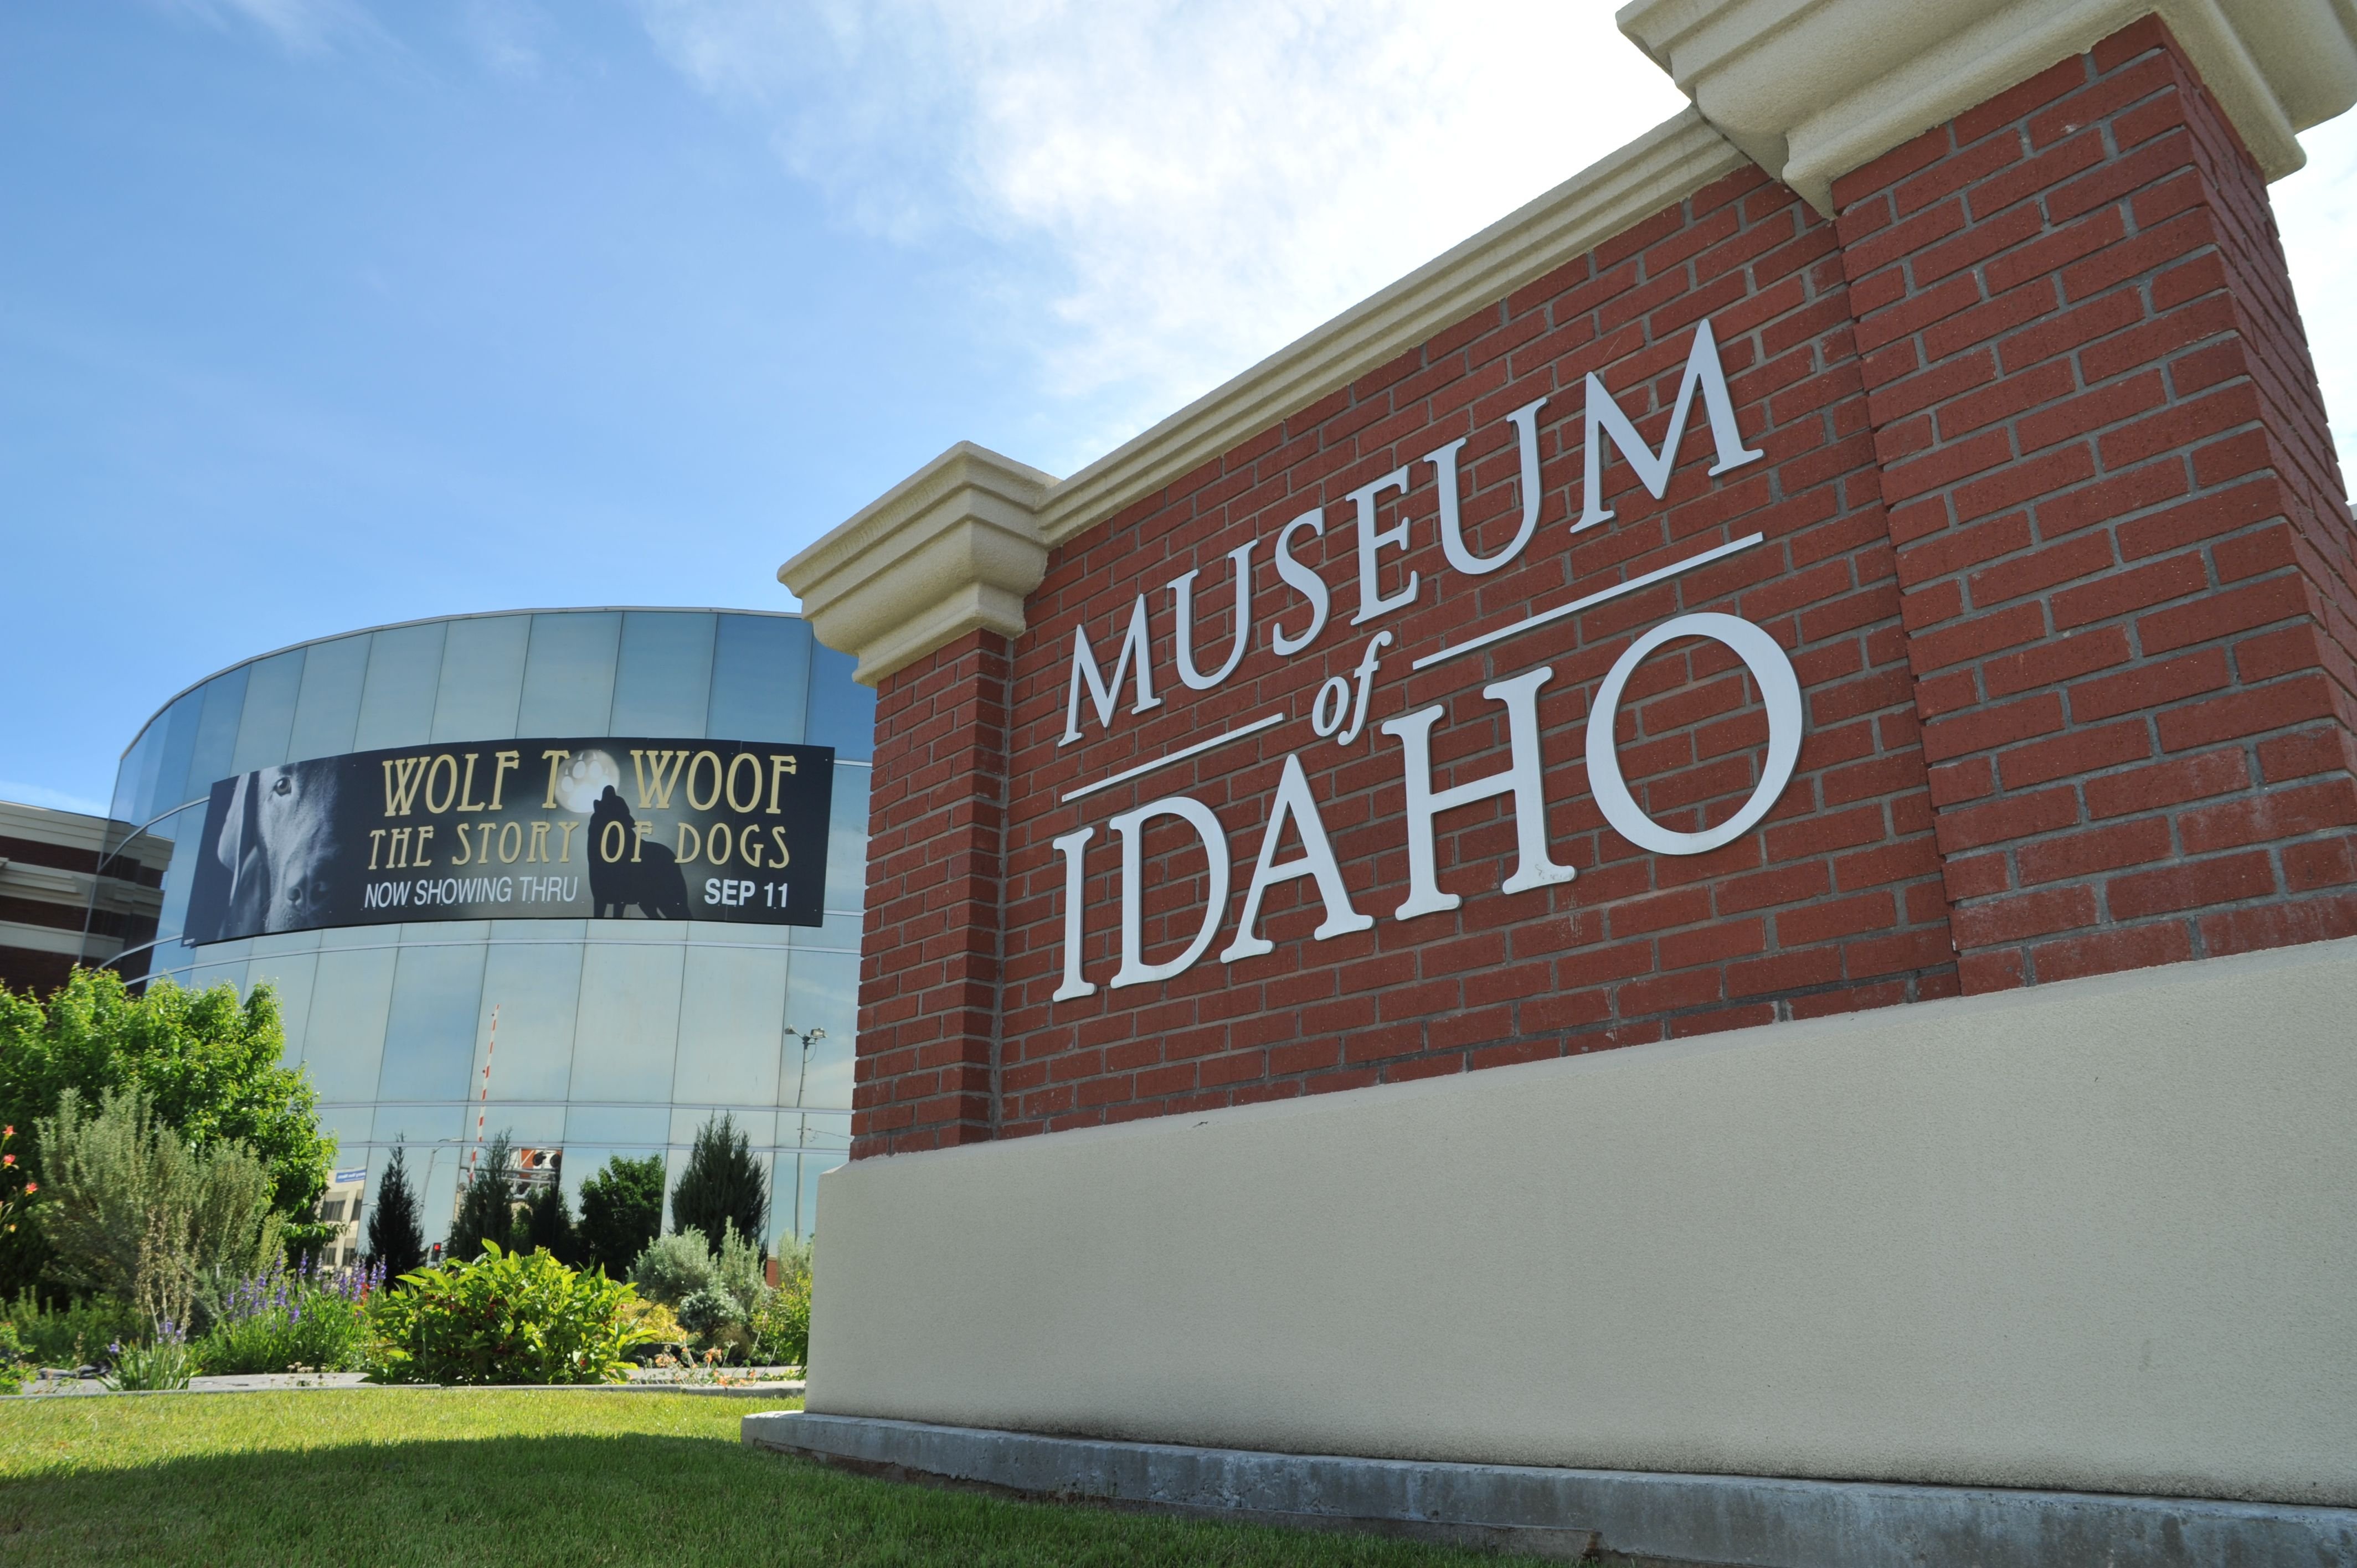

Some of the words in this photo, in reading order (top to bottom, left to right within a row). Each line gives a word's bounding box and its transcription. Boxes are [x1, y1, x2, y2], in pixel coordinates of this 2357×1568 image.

[1058, 318, 1764, 747] MUSEUM
[1311, 631, 1392, 745] of
[382, 750, 519, 817] WOLF
[630, 750, 797, 814] WOOF
[1052, 612, 1803, 1002] IDAHO
[368, 826, 434, 870] THE
[452, 822, 579, 865] STORY
[601, 821, 652, 863] OF
[675, 822, 790, 869] DOGS
[364, 881, 411, 908] NOW
[414, 876, 512, 905] SHOWING
[519, 876, 578, 902] THRU
[704, 878, 755, 906] SEP
[764, 882, 788, 907] 11
